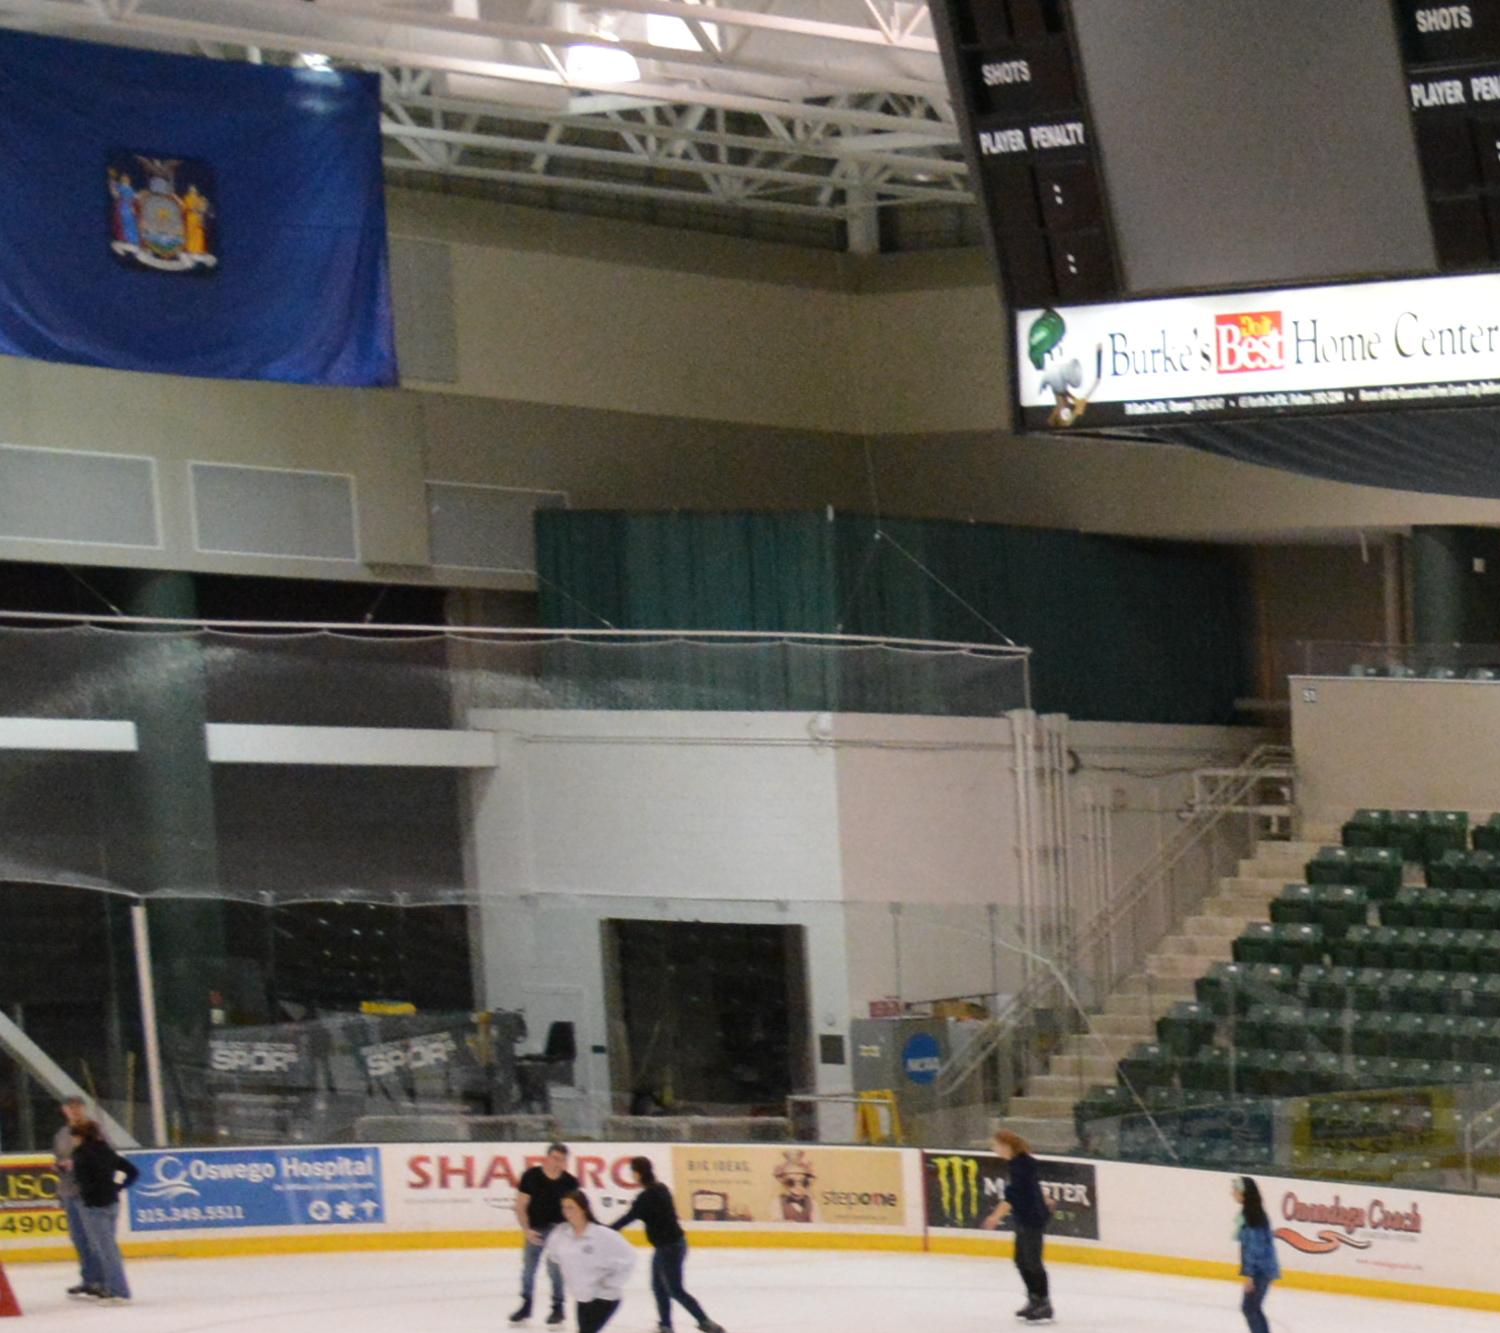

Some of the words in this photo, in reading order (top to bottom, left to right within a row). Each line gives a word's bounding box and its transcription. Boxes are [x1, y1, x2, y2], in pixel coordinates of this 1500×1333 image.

[1416, 6, 1472, 32] SHOTS
[982, 59, 1031, 86] SHOTS
[1411, 80, 1466, 107] PLAYER
[979, 129, 1027, 155] PLAYER
[1029, 122, 1085, 149] PENALTY
[1109, 326, 1212, 377] Burke's
[1216, 323, 1284, 371] Best
[1292, 318, 1382, 364] Home
[1394, 311, 1500, 358] Center
[189, 1159, 276, 1183] Oswego
[282, 1156, 375, 1180] Hospital
